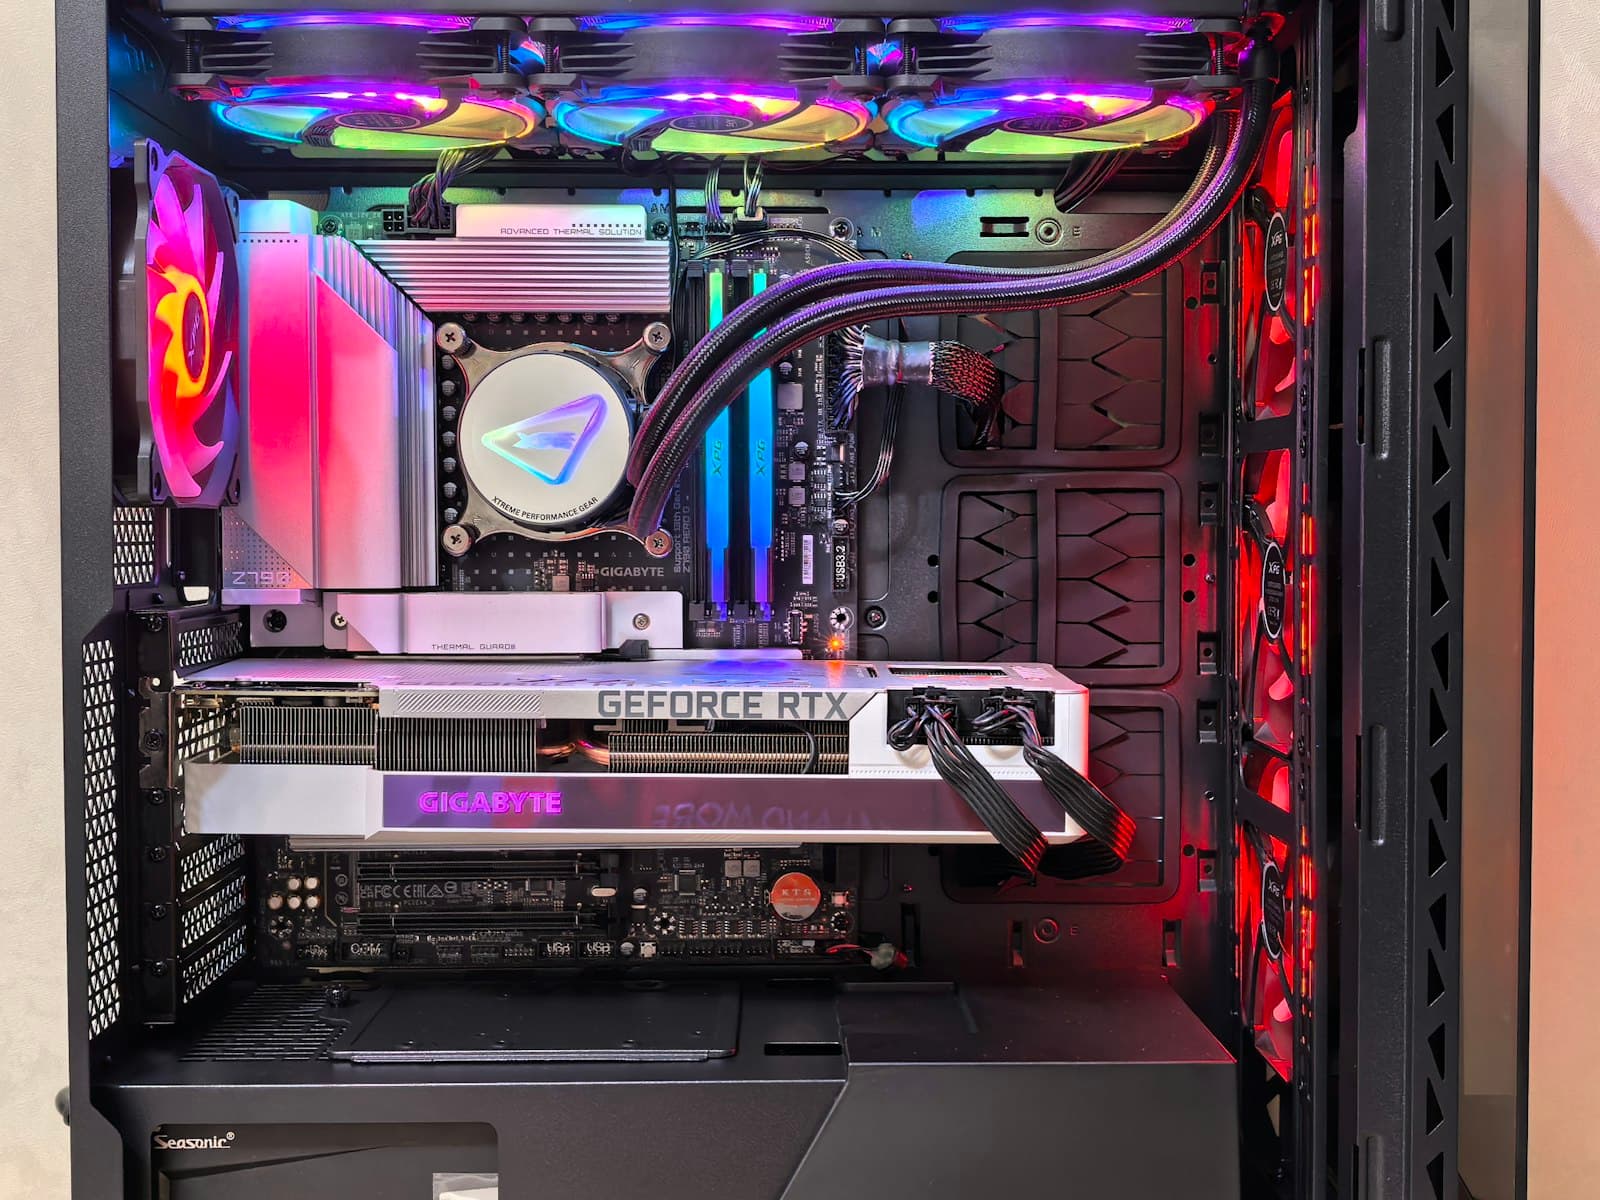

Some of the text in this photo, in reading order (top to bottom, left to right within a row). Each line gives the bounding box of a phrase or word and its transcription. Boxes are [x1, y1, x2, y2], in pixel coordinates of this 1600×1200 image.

[500, 228, 642, 236] ADVANCED THERMAL SOLUTION
[1271, 231, 1283, 248] XPG
[713, 440, 723, 477] XPG
[756, 439, 767, 477] XPG
[491, 496, 599, 521] XTREME PERFORMANCE GEAR
[673, 534, 682, 573] Support
[835, 545, 846, 581] USB3.2
[600, 567, 665, 578] GIGABYTE
[1268, 561, 1281, 575] XPG
[598, 690, 848, 719] GEFORCE RTX
[418, 791, 563, 815] GIGABYTE
